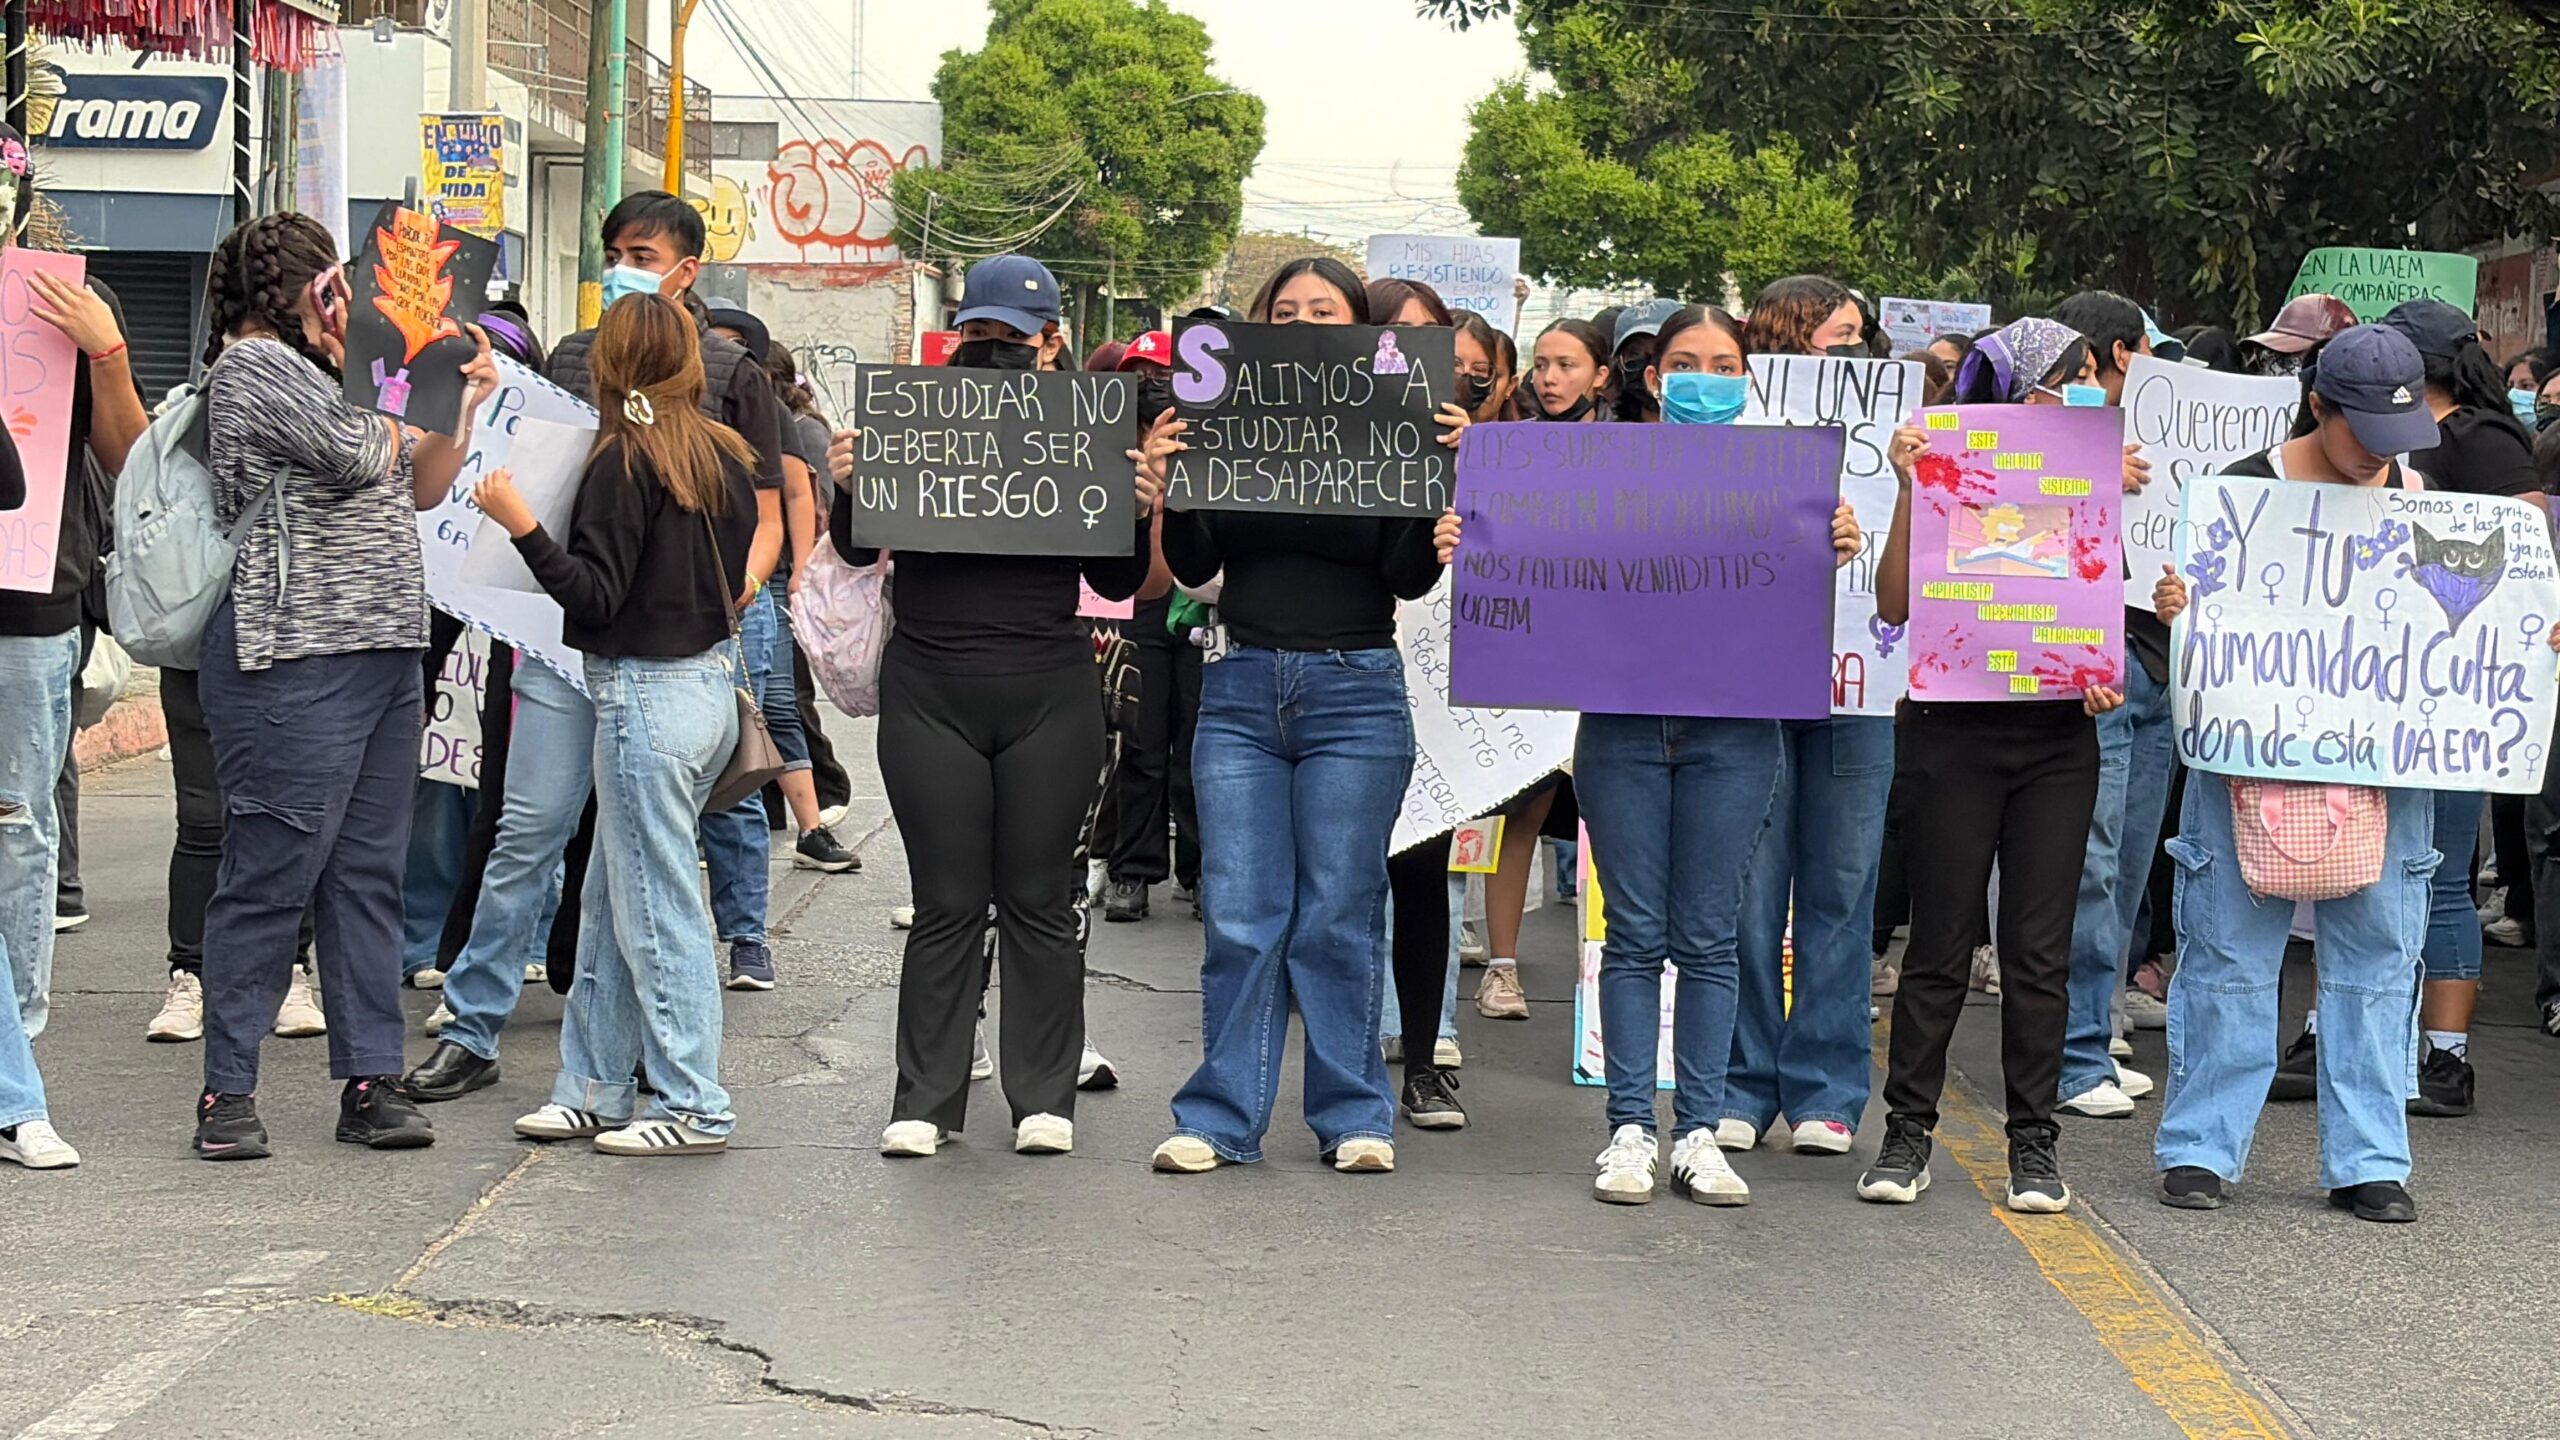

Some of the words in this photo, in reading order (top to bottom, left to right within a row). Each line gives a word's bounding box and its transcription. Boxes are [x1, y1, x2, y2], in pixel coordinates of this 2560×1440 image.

[50, 99, 201, 140] rama
[441, 183, 486, 197] VIDA
[445, 166, 467, 178] DE
[1404, 242, 1432, 262] MIS
[2339, 252, 2361, 277] LA
[2370, 254, 2424, 279] UAEM
[1172, 324, 1374, 406] SALIMOS
[1401, 357, 1432, 409] A
[866, 371, 1043, 421] ESTUDIAR
[1071, 377, 1125, 426] NO
[1814, 359, 1905, 423] UNA
[1175, 415, 1341, 454] ESTUDIAR
[1370, 421, 1419, 457] NO
[1928, 414, 1957, 429] TODO
[863, 426, 1003, 469] DEBERIA
[1023, 432, 1093, 471] SER
[1969, 433, 1997, 449] ESTE
[859, 475, 898, 512] UN
[1167, 459, 1192, 498] A
[1208, 455, 1446, 511] DESAPARECER
[2040, 478, 2091, 495] SISTEMA
[2389, 493, 2453, 514] Somos
[2464, 501, 2479, 514] el
[2219, 485, 2270, 592] Y
[2450, 515, 2466, 532] de
[2474, 516, 2493, 534] las
[2512, 522, 2541, 540] que
[1464, 548, 1511, 582] NOS
[1518, 555, 1606, 591] FALTAN
[2509, 541, 2532, 562] ya
[2536, 545, 2550, 559] no
[1988, 653, 2015, 671] ESTÁ
[2181, 585, 2411, 706] humanidad
[2312, 718, 2377, 772] está
[2393, 707, 2527, 778] UAEM?
